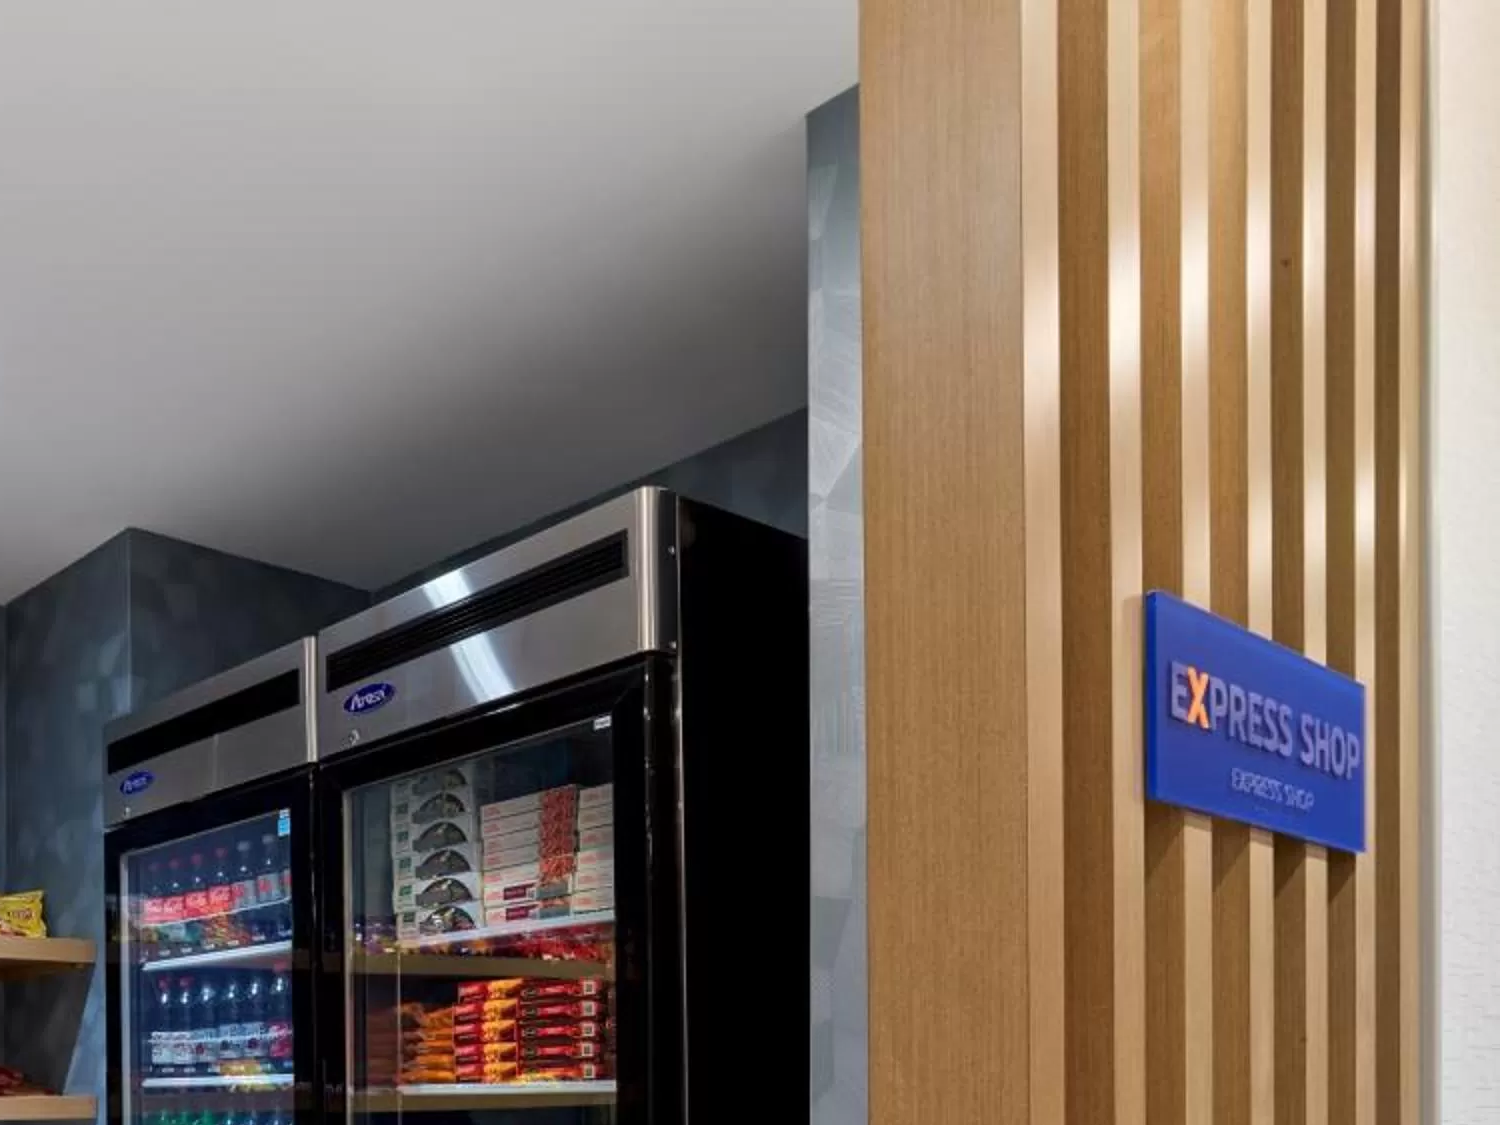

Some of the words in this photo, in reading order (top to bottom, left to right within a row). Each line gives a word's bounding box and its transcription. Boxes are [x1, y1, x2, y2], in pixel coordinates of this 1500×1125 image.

[1170, 660, 1294, 758] EXPRESS
[1300, 713, 1361, 780] SHOP
[1231, 767, 1283, 803] EXPRESS
